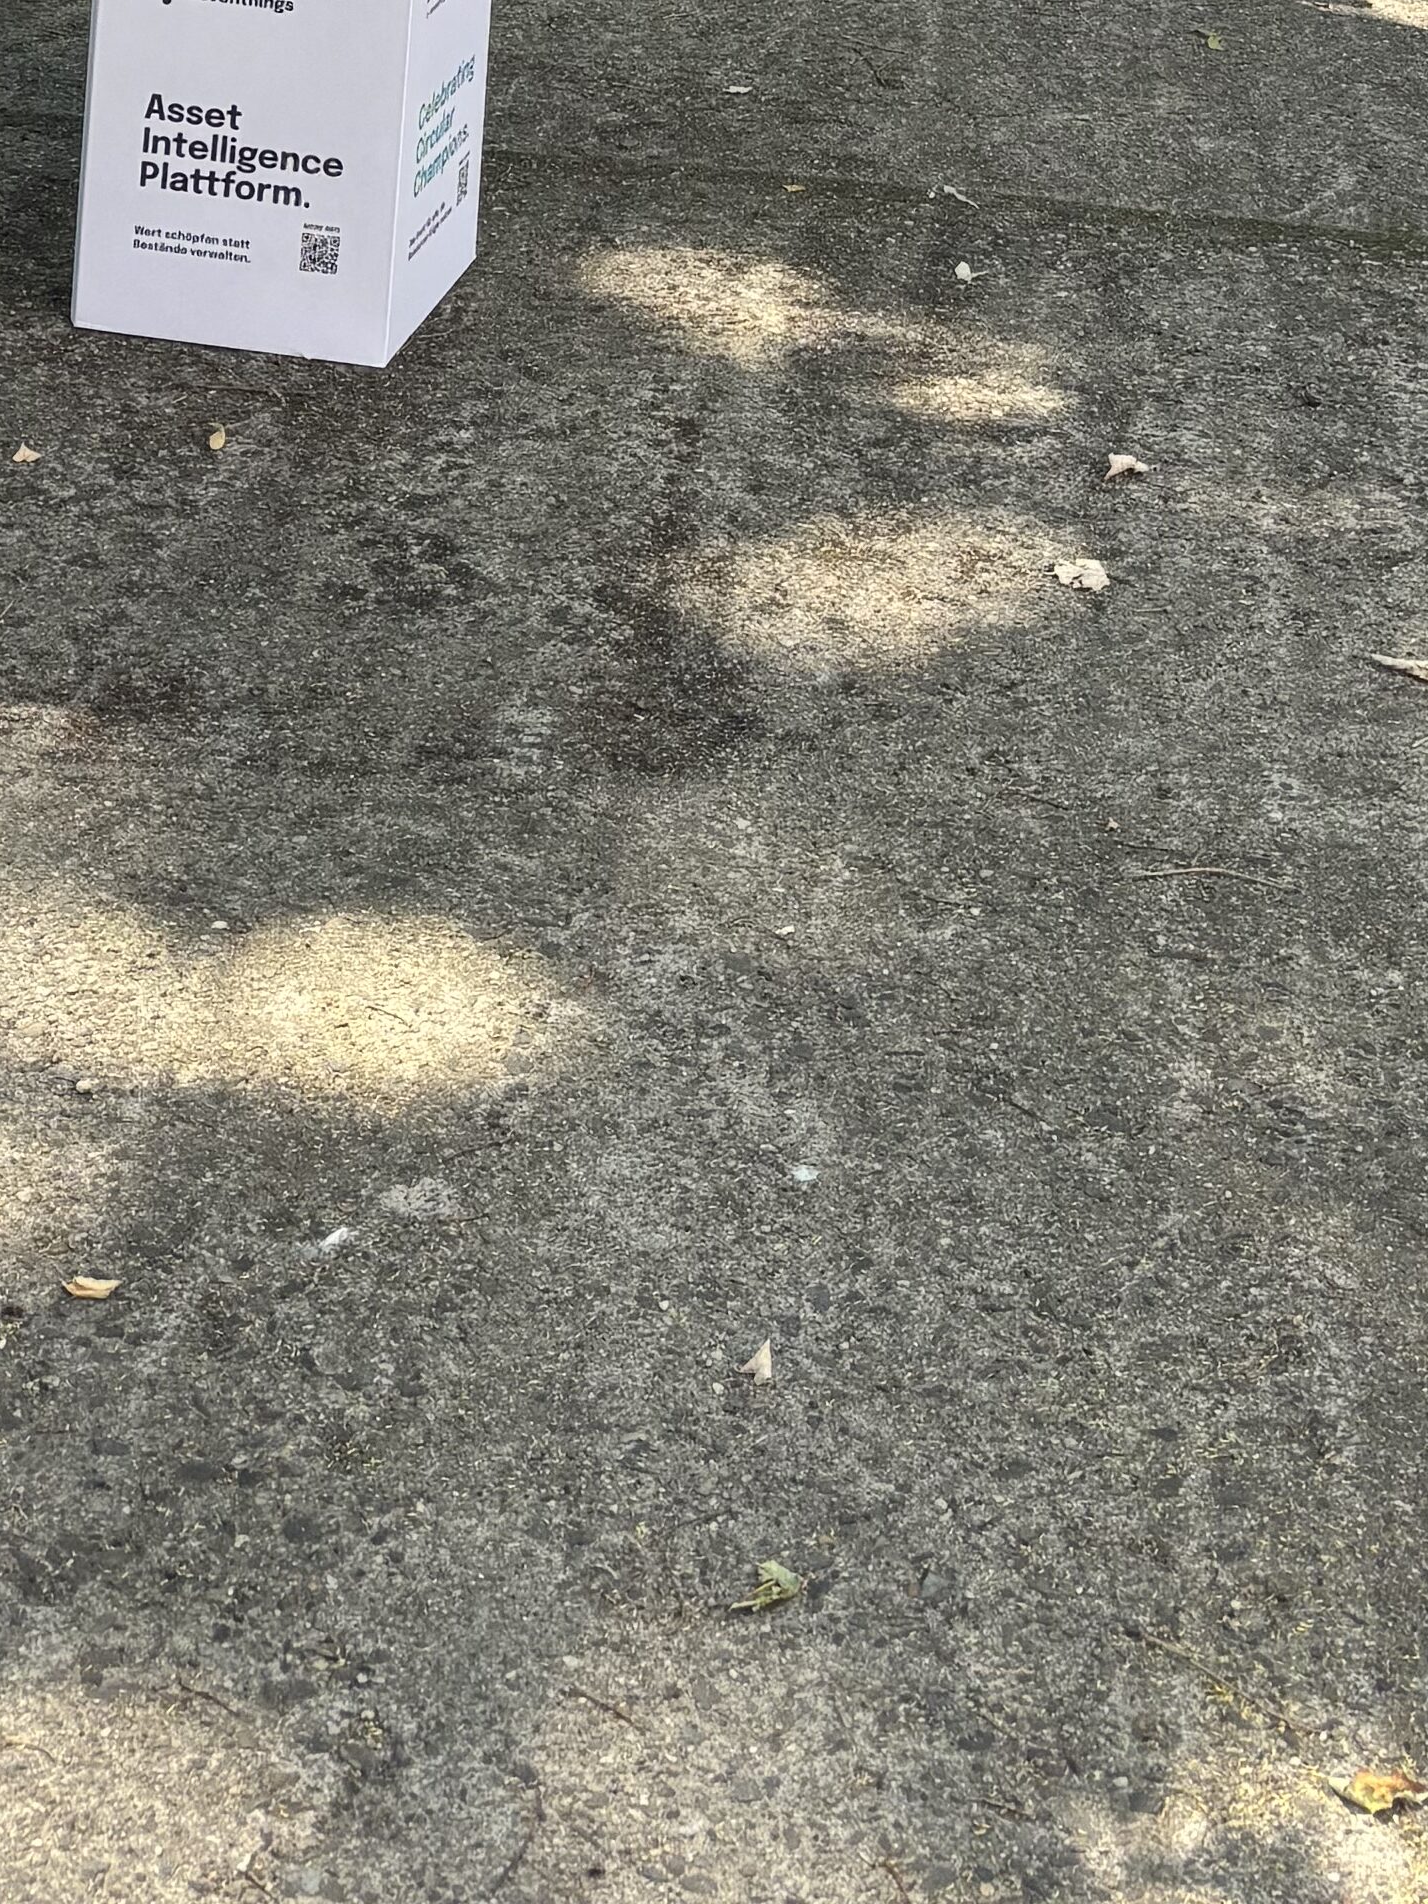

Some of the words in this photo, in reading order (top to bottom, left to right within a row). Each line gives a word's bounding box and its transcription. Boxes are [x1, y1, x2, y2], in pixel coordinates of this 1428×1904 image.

[145, 93, 242, 130] Asset
[419, 54, 475, 130] Celebrating
[142, 126, 344, 177] Intelligence
[416, 107, 455, 164] Circular
[140, 160, 310, 208] Plattform.
[134, 225, 161, 238] Wert
[222, 238, 251, 250] statt
